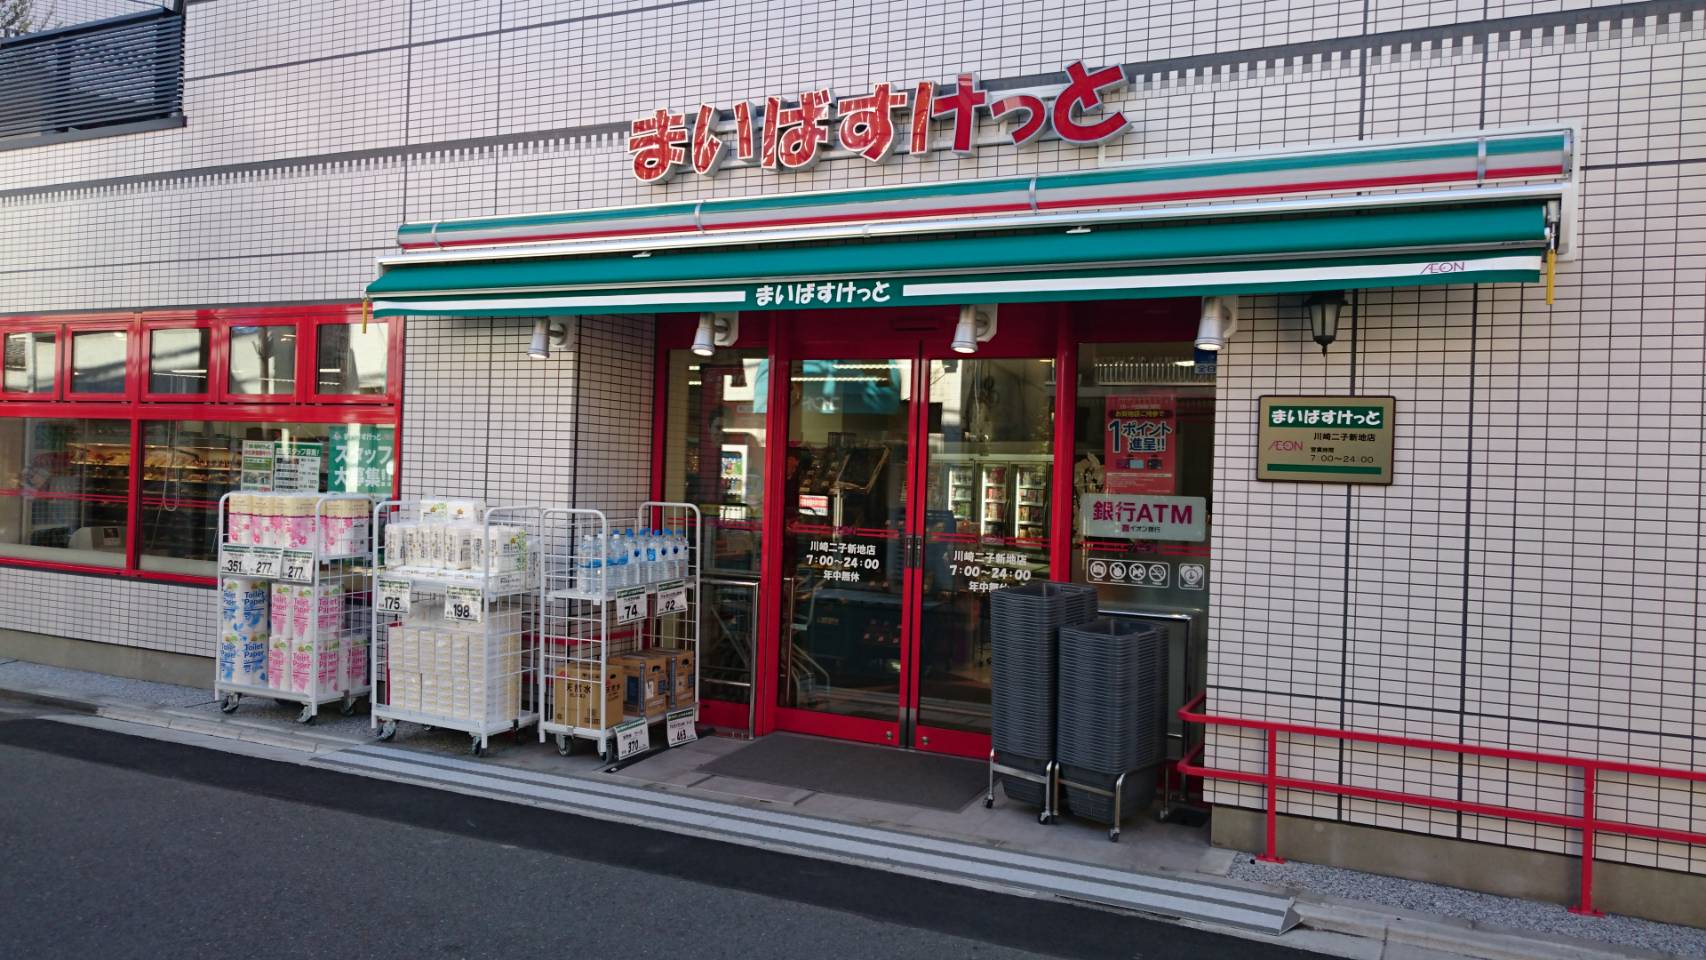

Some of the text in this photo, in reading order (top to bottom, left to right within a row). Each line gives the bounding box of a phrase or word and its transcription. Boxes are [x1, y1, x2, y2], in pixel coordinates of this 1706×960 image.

[628, 59, 1129, 184] まいばすけっと
[756, 281, 891, 306] まいばすけっと
[1271, 409, 1381, 425] まいばすけっと
[1313, 432, 1376, 441] 川崎二子新地店
[1092, 501, 1193, 525] 銀行ATM
[810, 541, 877, 555] 川崎二子新地店
[953, 550, 1027, 565] 川崎二子新地店
[227, 560, 243, 573] 351
[256, 561, 272, 574] 277
[288, 566, 303, 578] 277
[824, 570, 860, 582] 年中無休
[384, 596, 400, 610] 175
[453, 604, 470, 618] 198
[624, 604, 637, 619] 74
